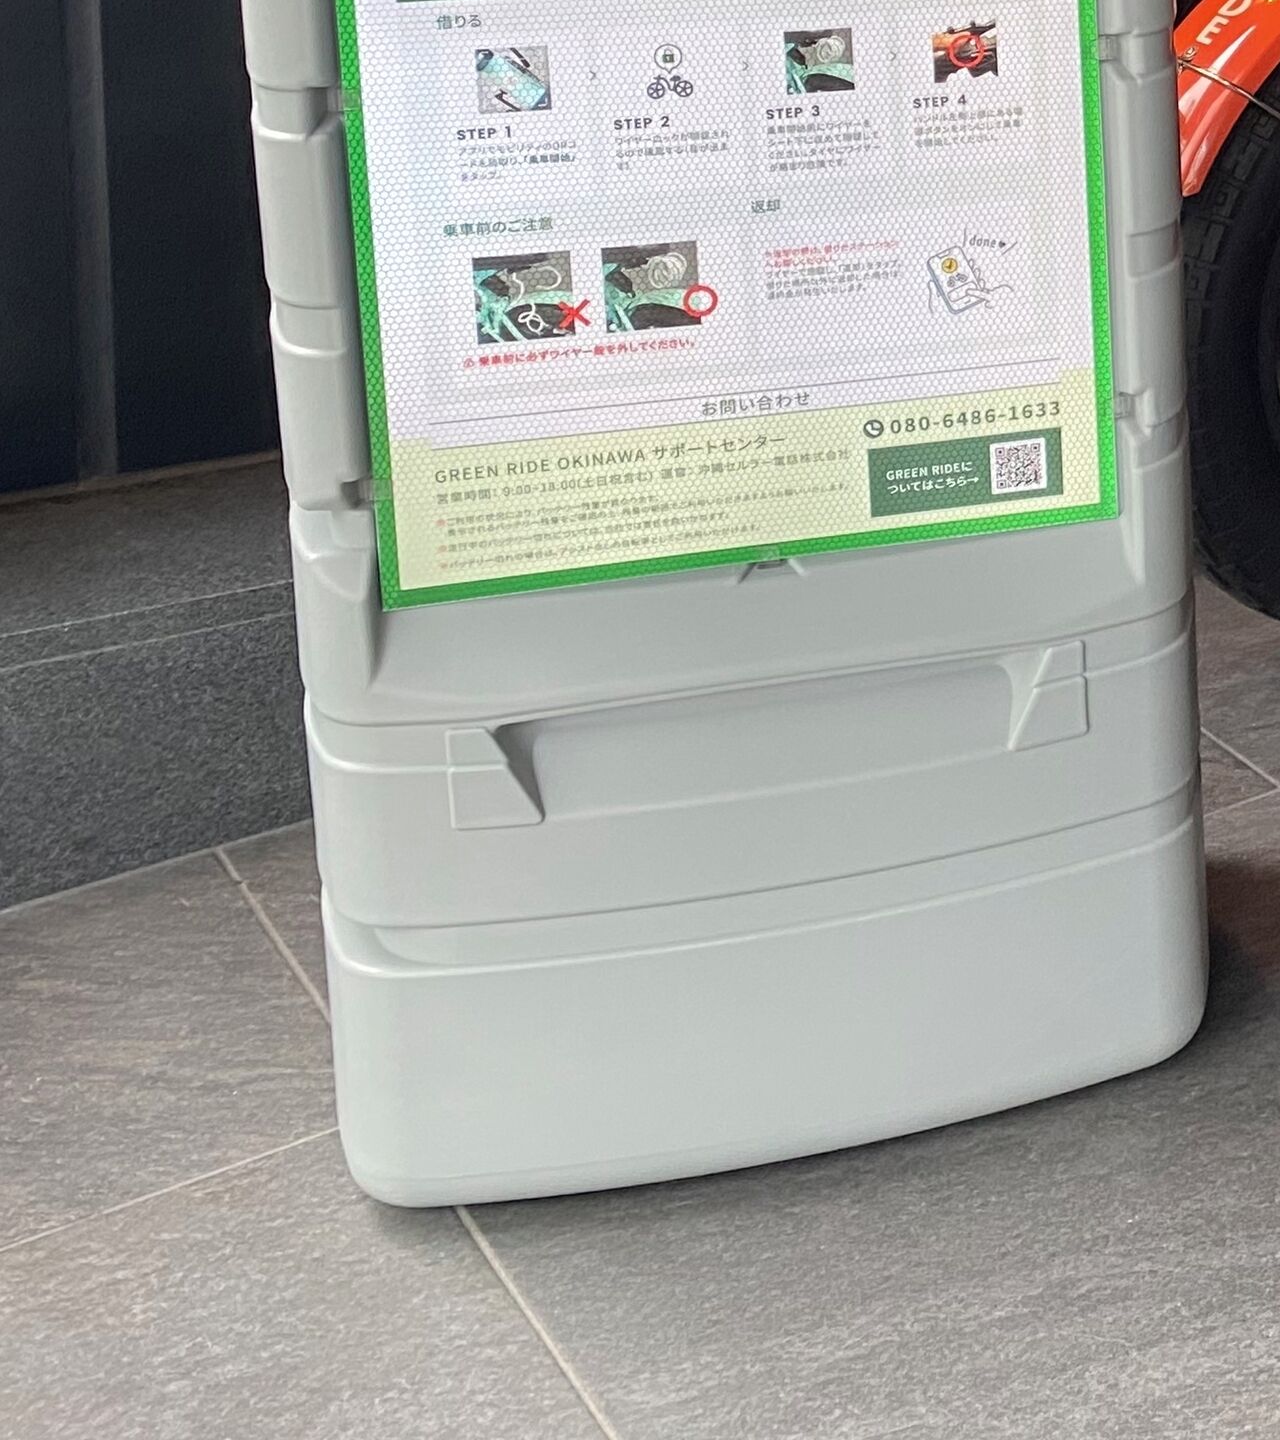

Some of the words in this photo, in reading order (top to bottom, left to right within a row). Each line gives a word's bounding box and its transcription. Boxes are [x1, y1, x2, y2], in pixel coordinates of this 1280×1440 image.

[436, 14, 482, 30] 借りる
[913, 96, 949, 109] STEP
[957, 94, 967, 106] 4
[766, 108, 803, 120] STEP
[811, 105, 821, 117] 3
[614, 118, 652, 130] STEP
[661, 116, 670, 128] 2
[457, 128, 497, 141] STEP
[505, 126, 513, 138] 1
[751, 199, 781, 212] 返却
[443, 217, 553, 238] 乗車前のご注意
[969, 234, 997, 249] done
[701, 391, 811, 417] お問い合わせ
[890, 401, 1061, 434] 080-6486-1633
[435, 462, 499, 484] GREEN
[506, 457, 551, 476] RIDE
[557, 447, 646, 472] OKINAWA
[651, 433, 786, 460] サポートセンター
[886, 463, 929, 481] GREEN
[931, 461, 974, 477] RIDEに
